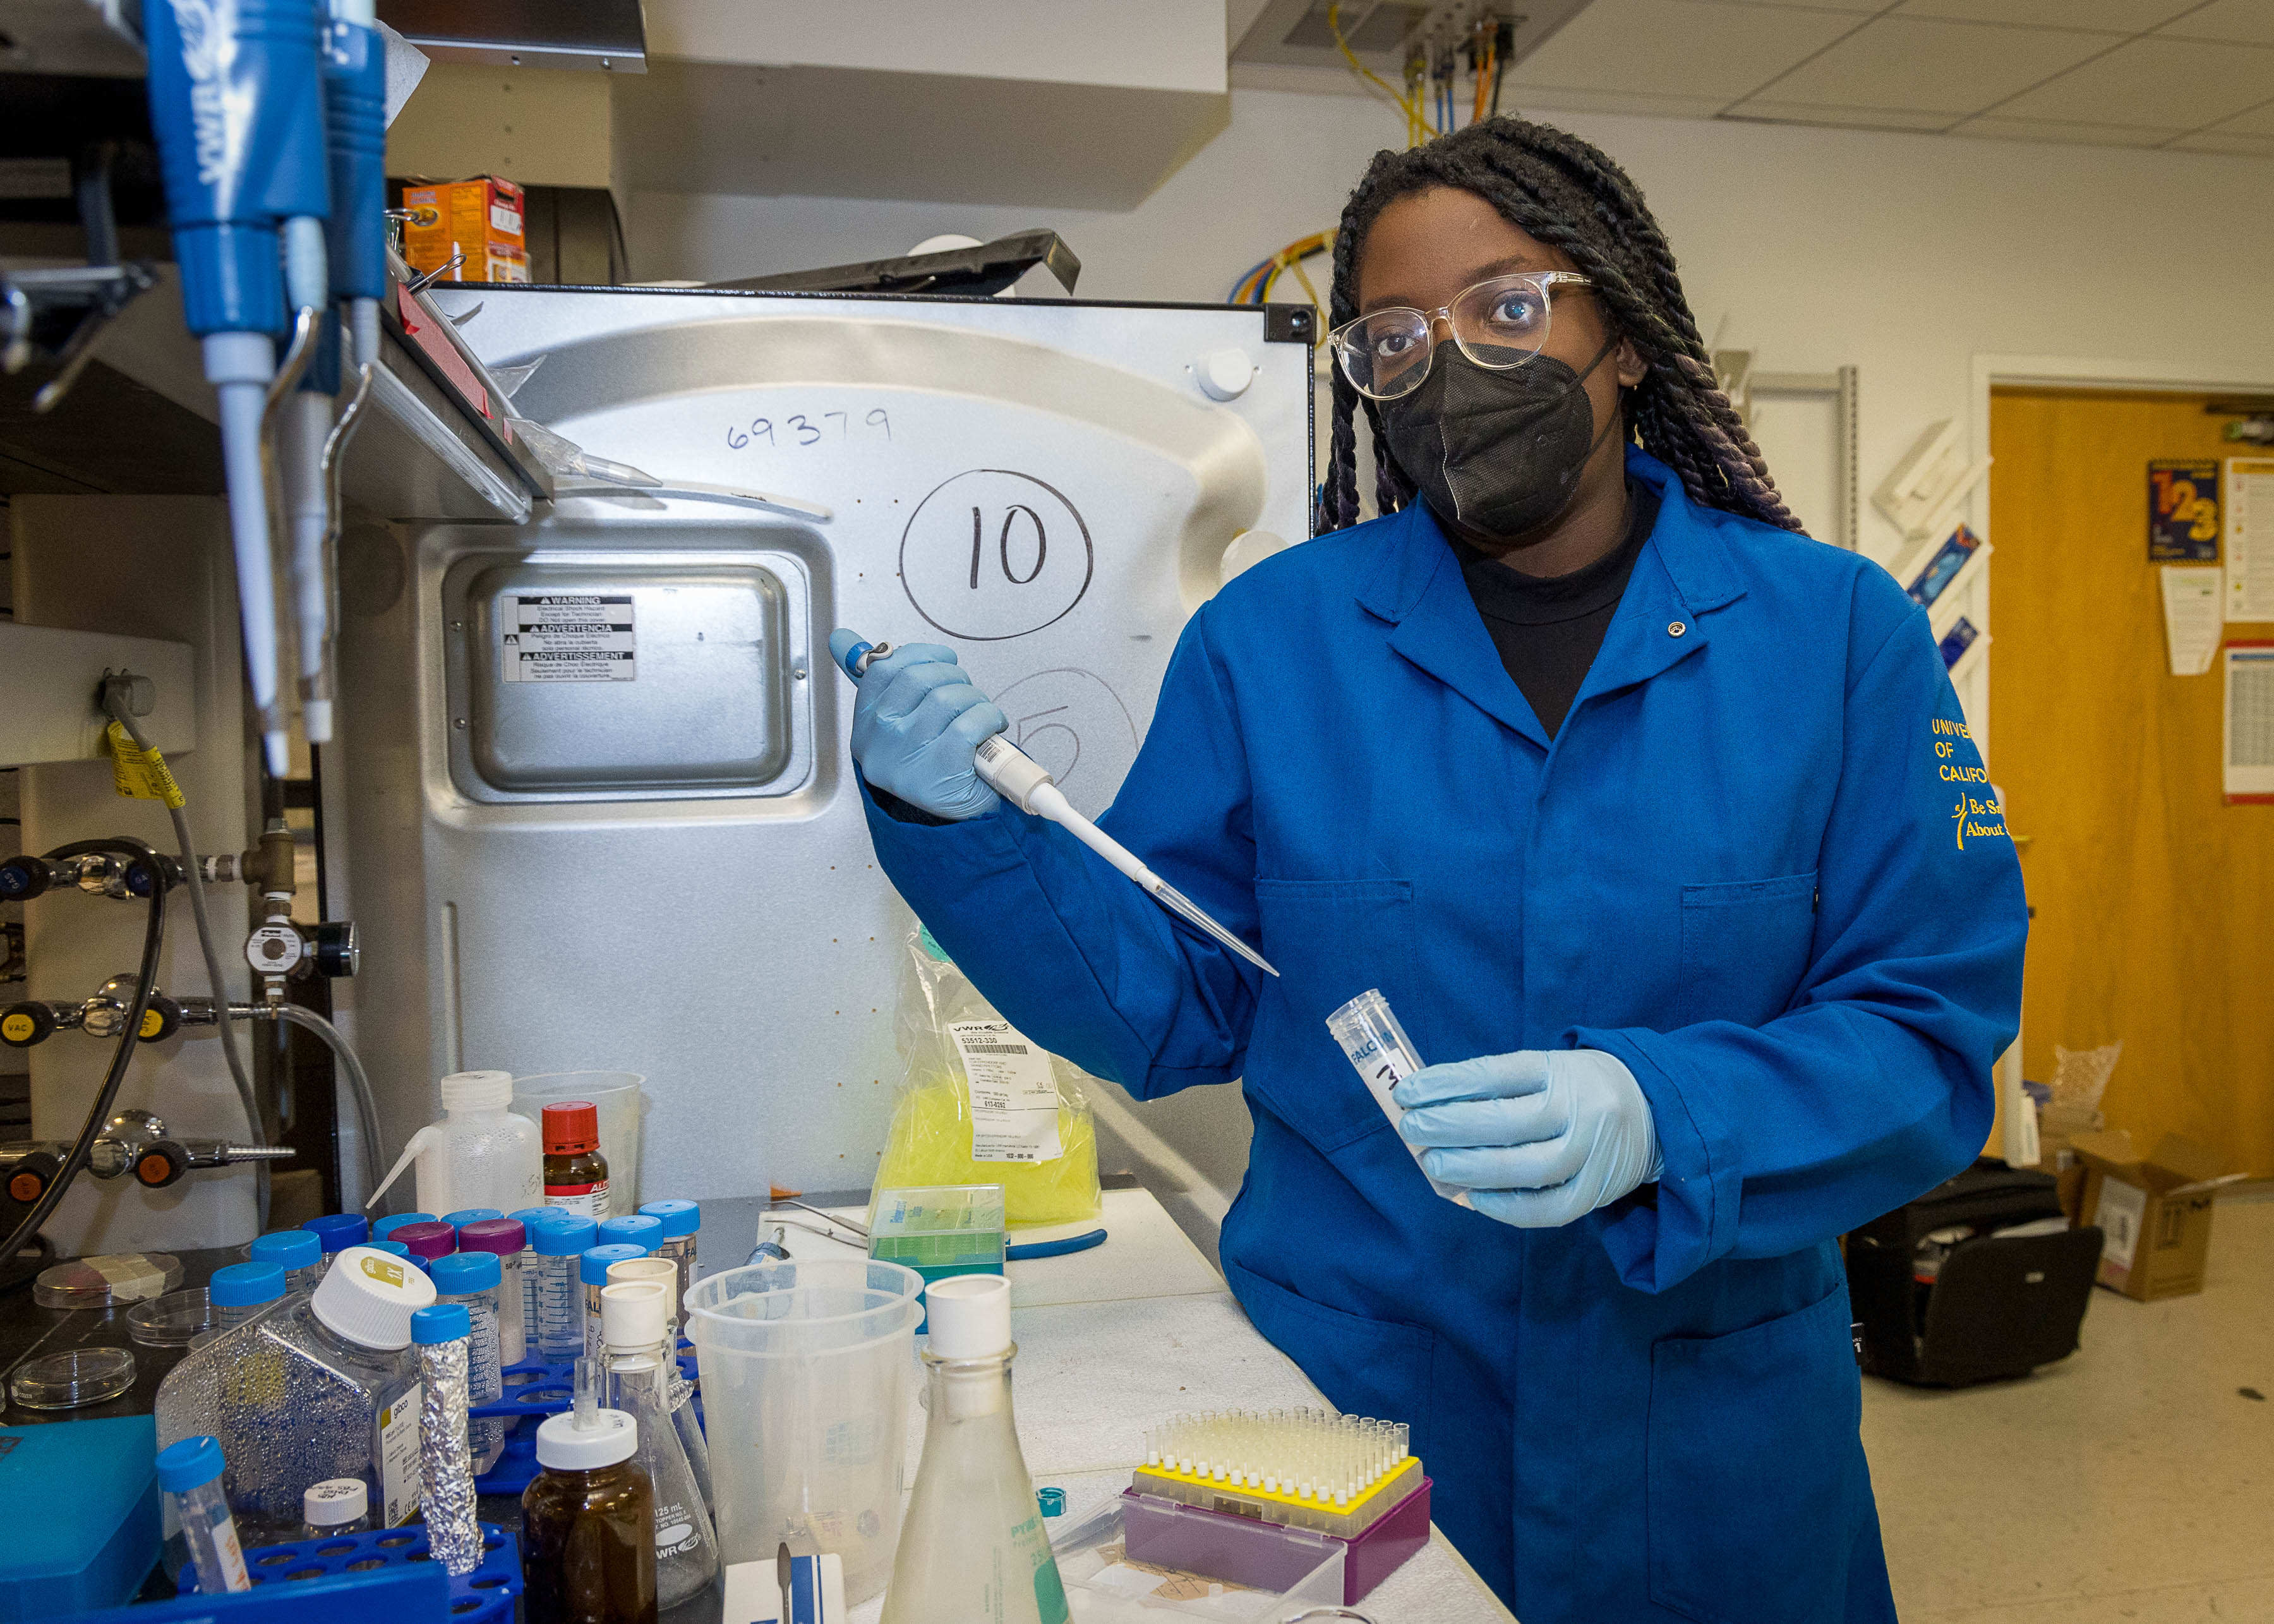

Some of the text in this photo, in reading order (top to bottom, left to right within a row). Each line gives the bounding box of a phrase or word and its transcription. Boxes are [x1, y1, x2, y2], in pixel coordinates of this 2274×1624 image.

[727, 409, 893, 450] 69379
[970, 505, 1046, 590] 10
[1016, 706, 1081, 785] 5
[1935, 742, 1953, 758] OF
[1939, 765, 1988, 783] CALIFO
[1969, 798, 1986, 814] Be
[1966, 822, 2005, 836] About
[1351, 1029, 1395, 1065] FALCN
[394, 1399, 408, 1419] gibco
[655, 1501, 683, 1517] 125 mL
